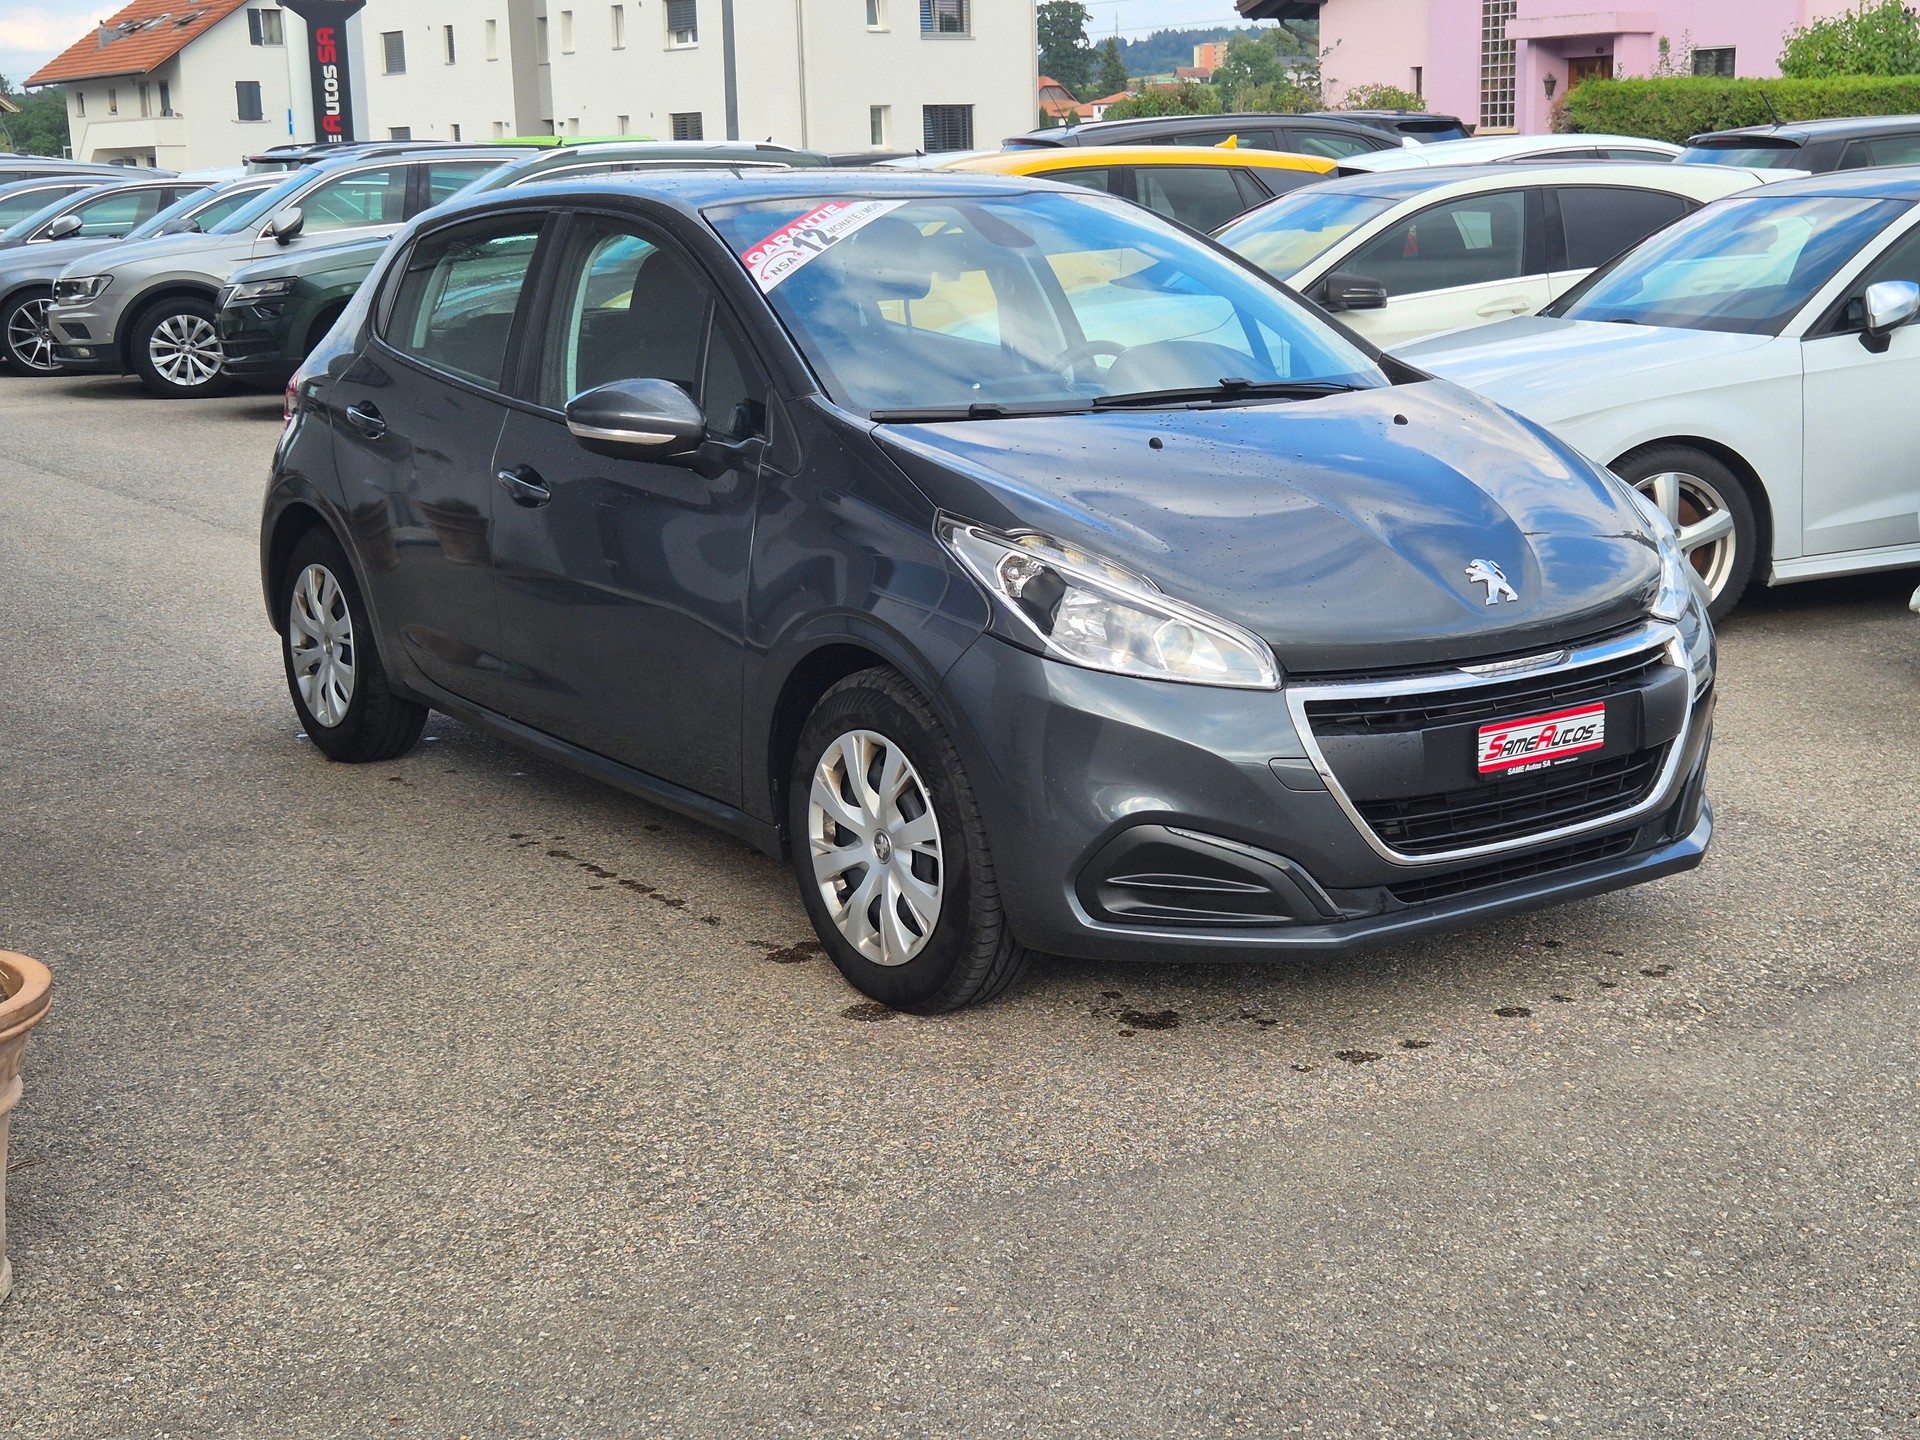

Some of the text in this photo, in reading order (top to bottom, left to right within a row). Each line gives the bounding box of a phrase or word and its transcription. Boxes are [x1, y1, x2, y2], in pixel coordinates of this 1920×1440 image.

[746, 204, 842, 264] GARANTIE
[792, 228, 840, 253] 12
[770, 256, 798, 276] NSA
[1507, 765, 1525, 776] SAME
[1542, 759, 1551, 768] SA
